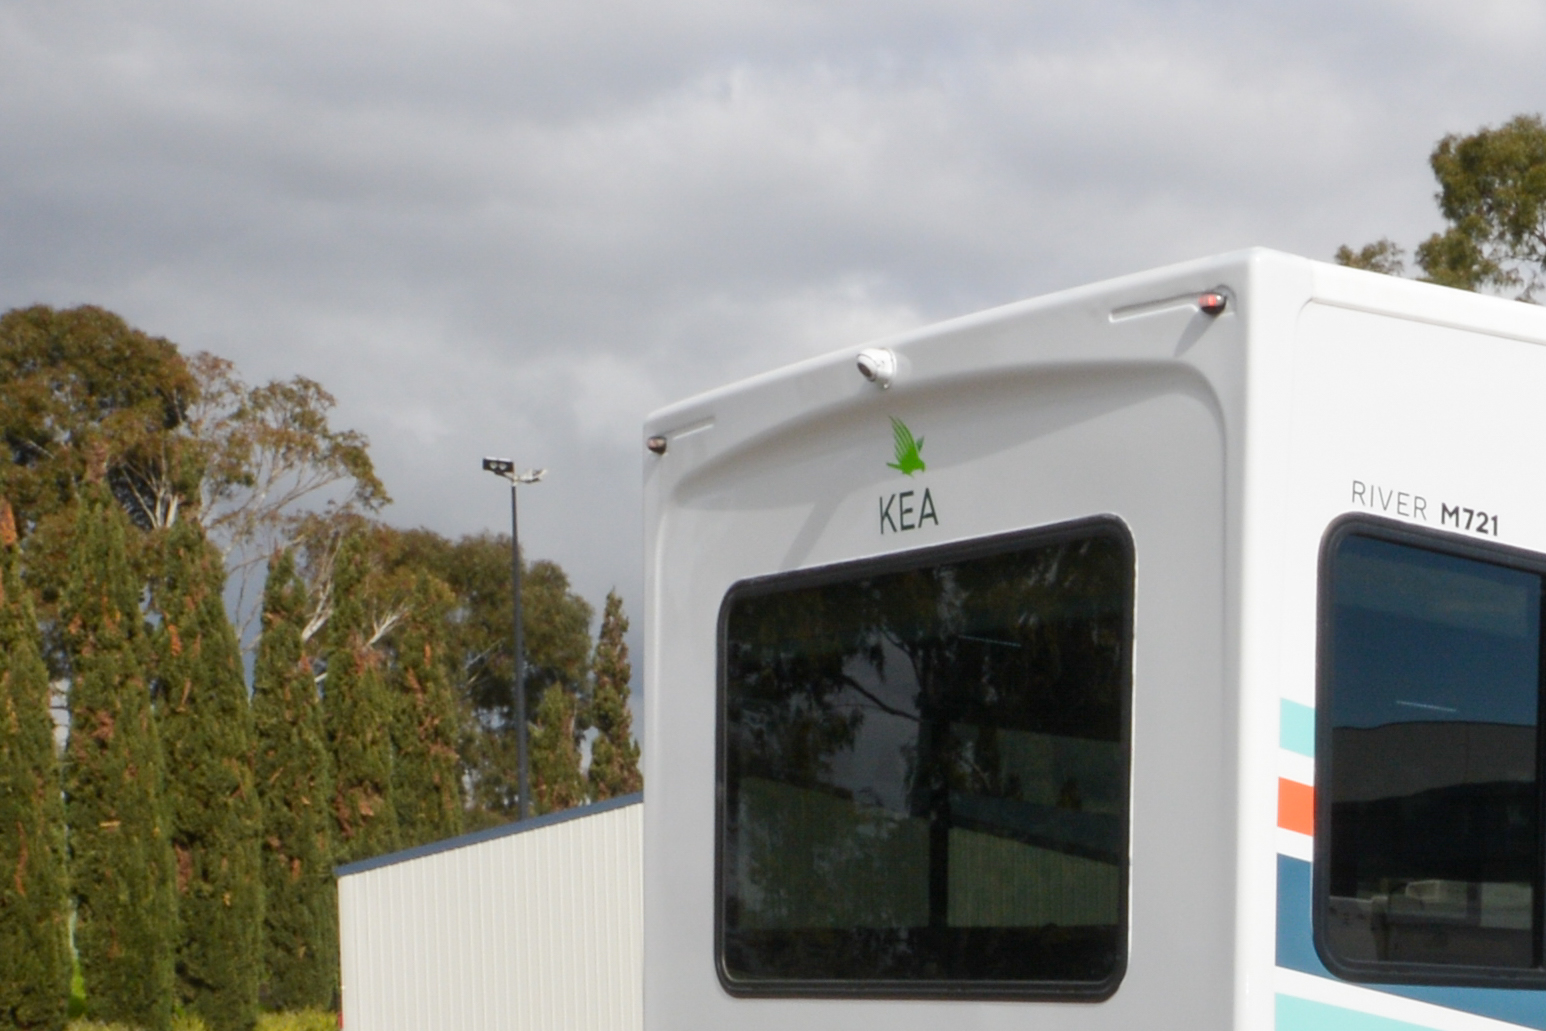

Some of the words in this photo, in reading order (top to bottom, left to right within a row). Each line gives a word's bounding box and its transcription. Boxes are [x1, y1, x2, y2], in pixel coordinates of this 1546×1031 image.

[880, 487, 939, 535] KEA
[1351, 480, 1427, 521] RIVER
[1441, 502, 1498, 537] M721
